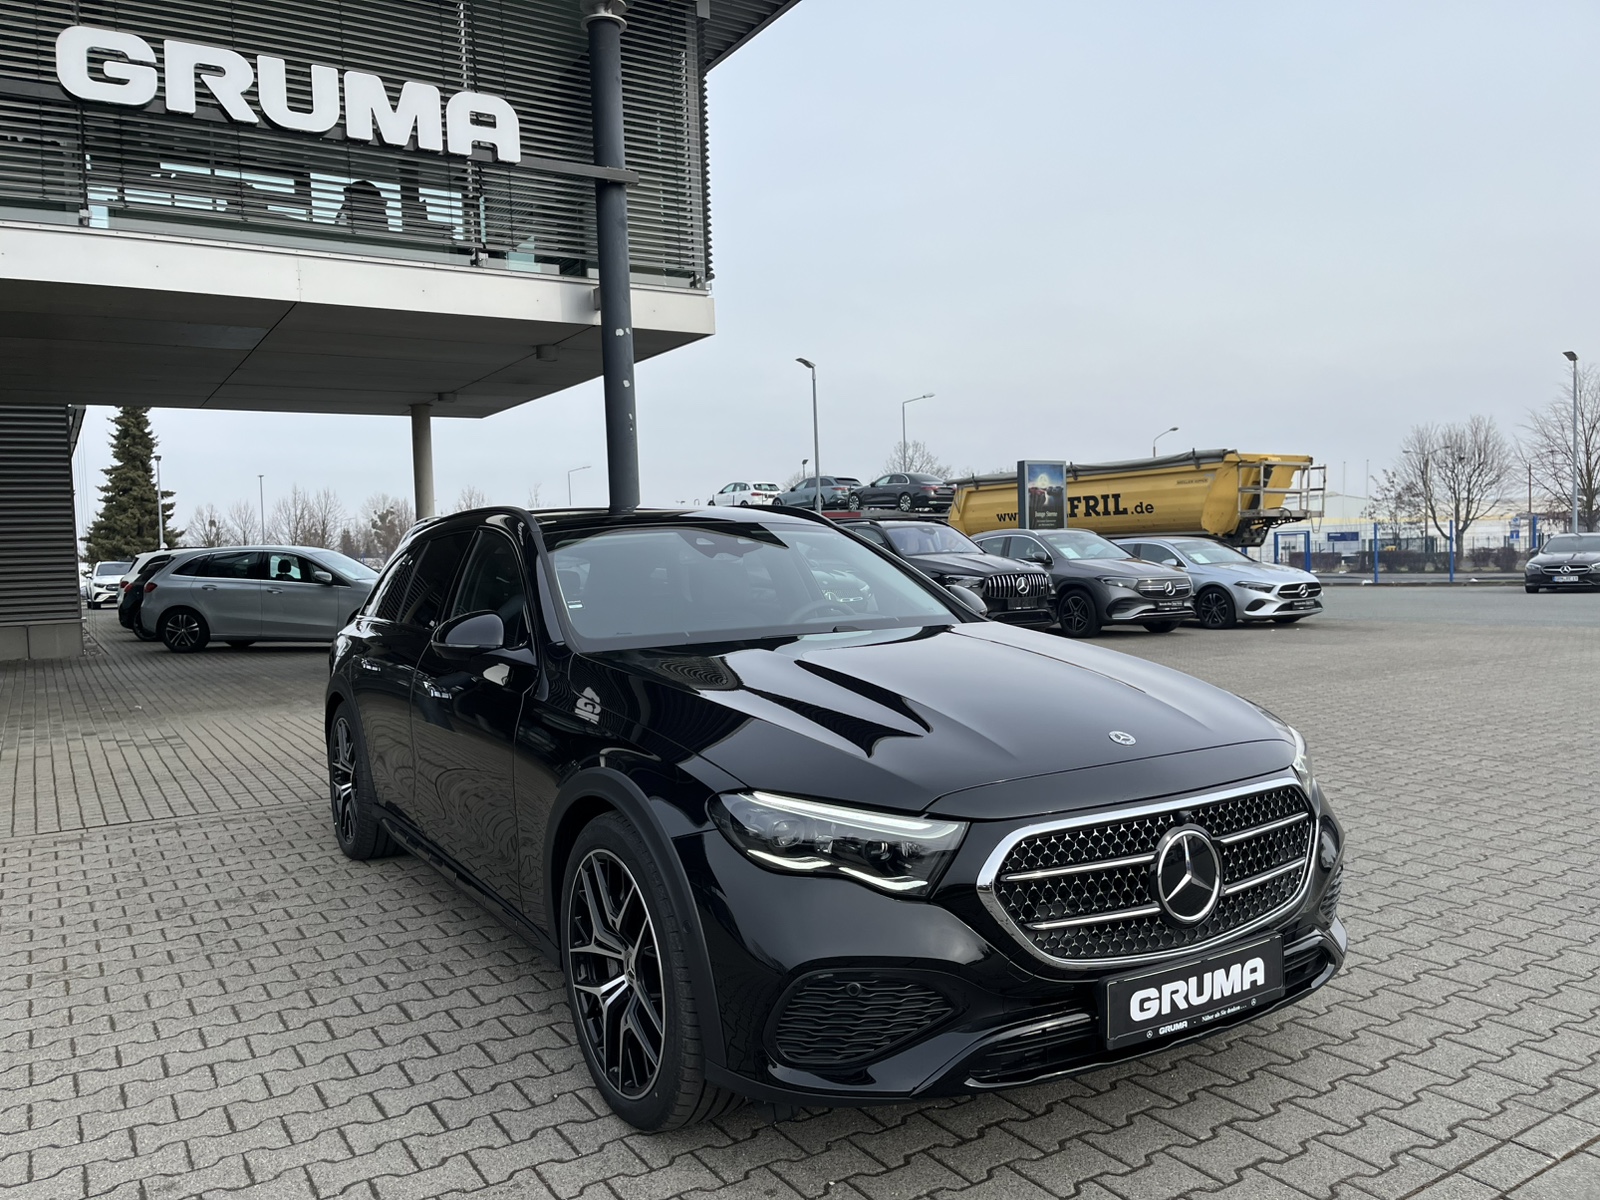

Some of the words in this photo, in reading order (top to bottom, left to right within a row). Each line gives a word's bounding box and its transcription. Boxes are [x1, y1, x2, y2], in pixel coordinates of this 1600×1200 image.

[55, 25, 521, 163] GRUMA
[1130, 957, 1265, 1022] GRUMA
[1159, 1020, 1188, 1035] GRUMA
